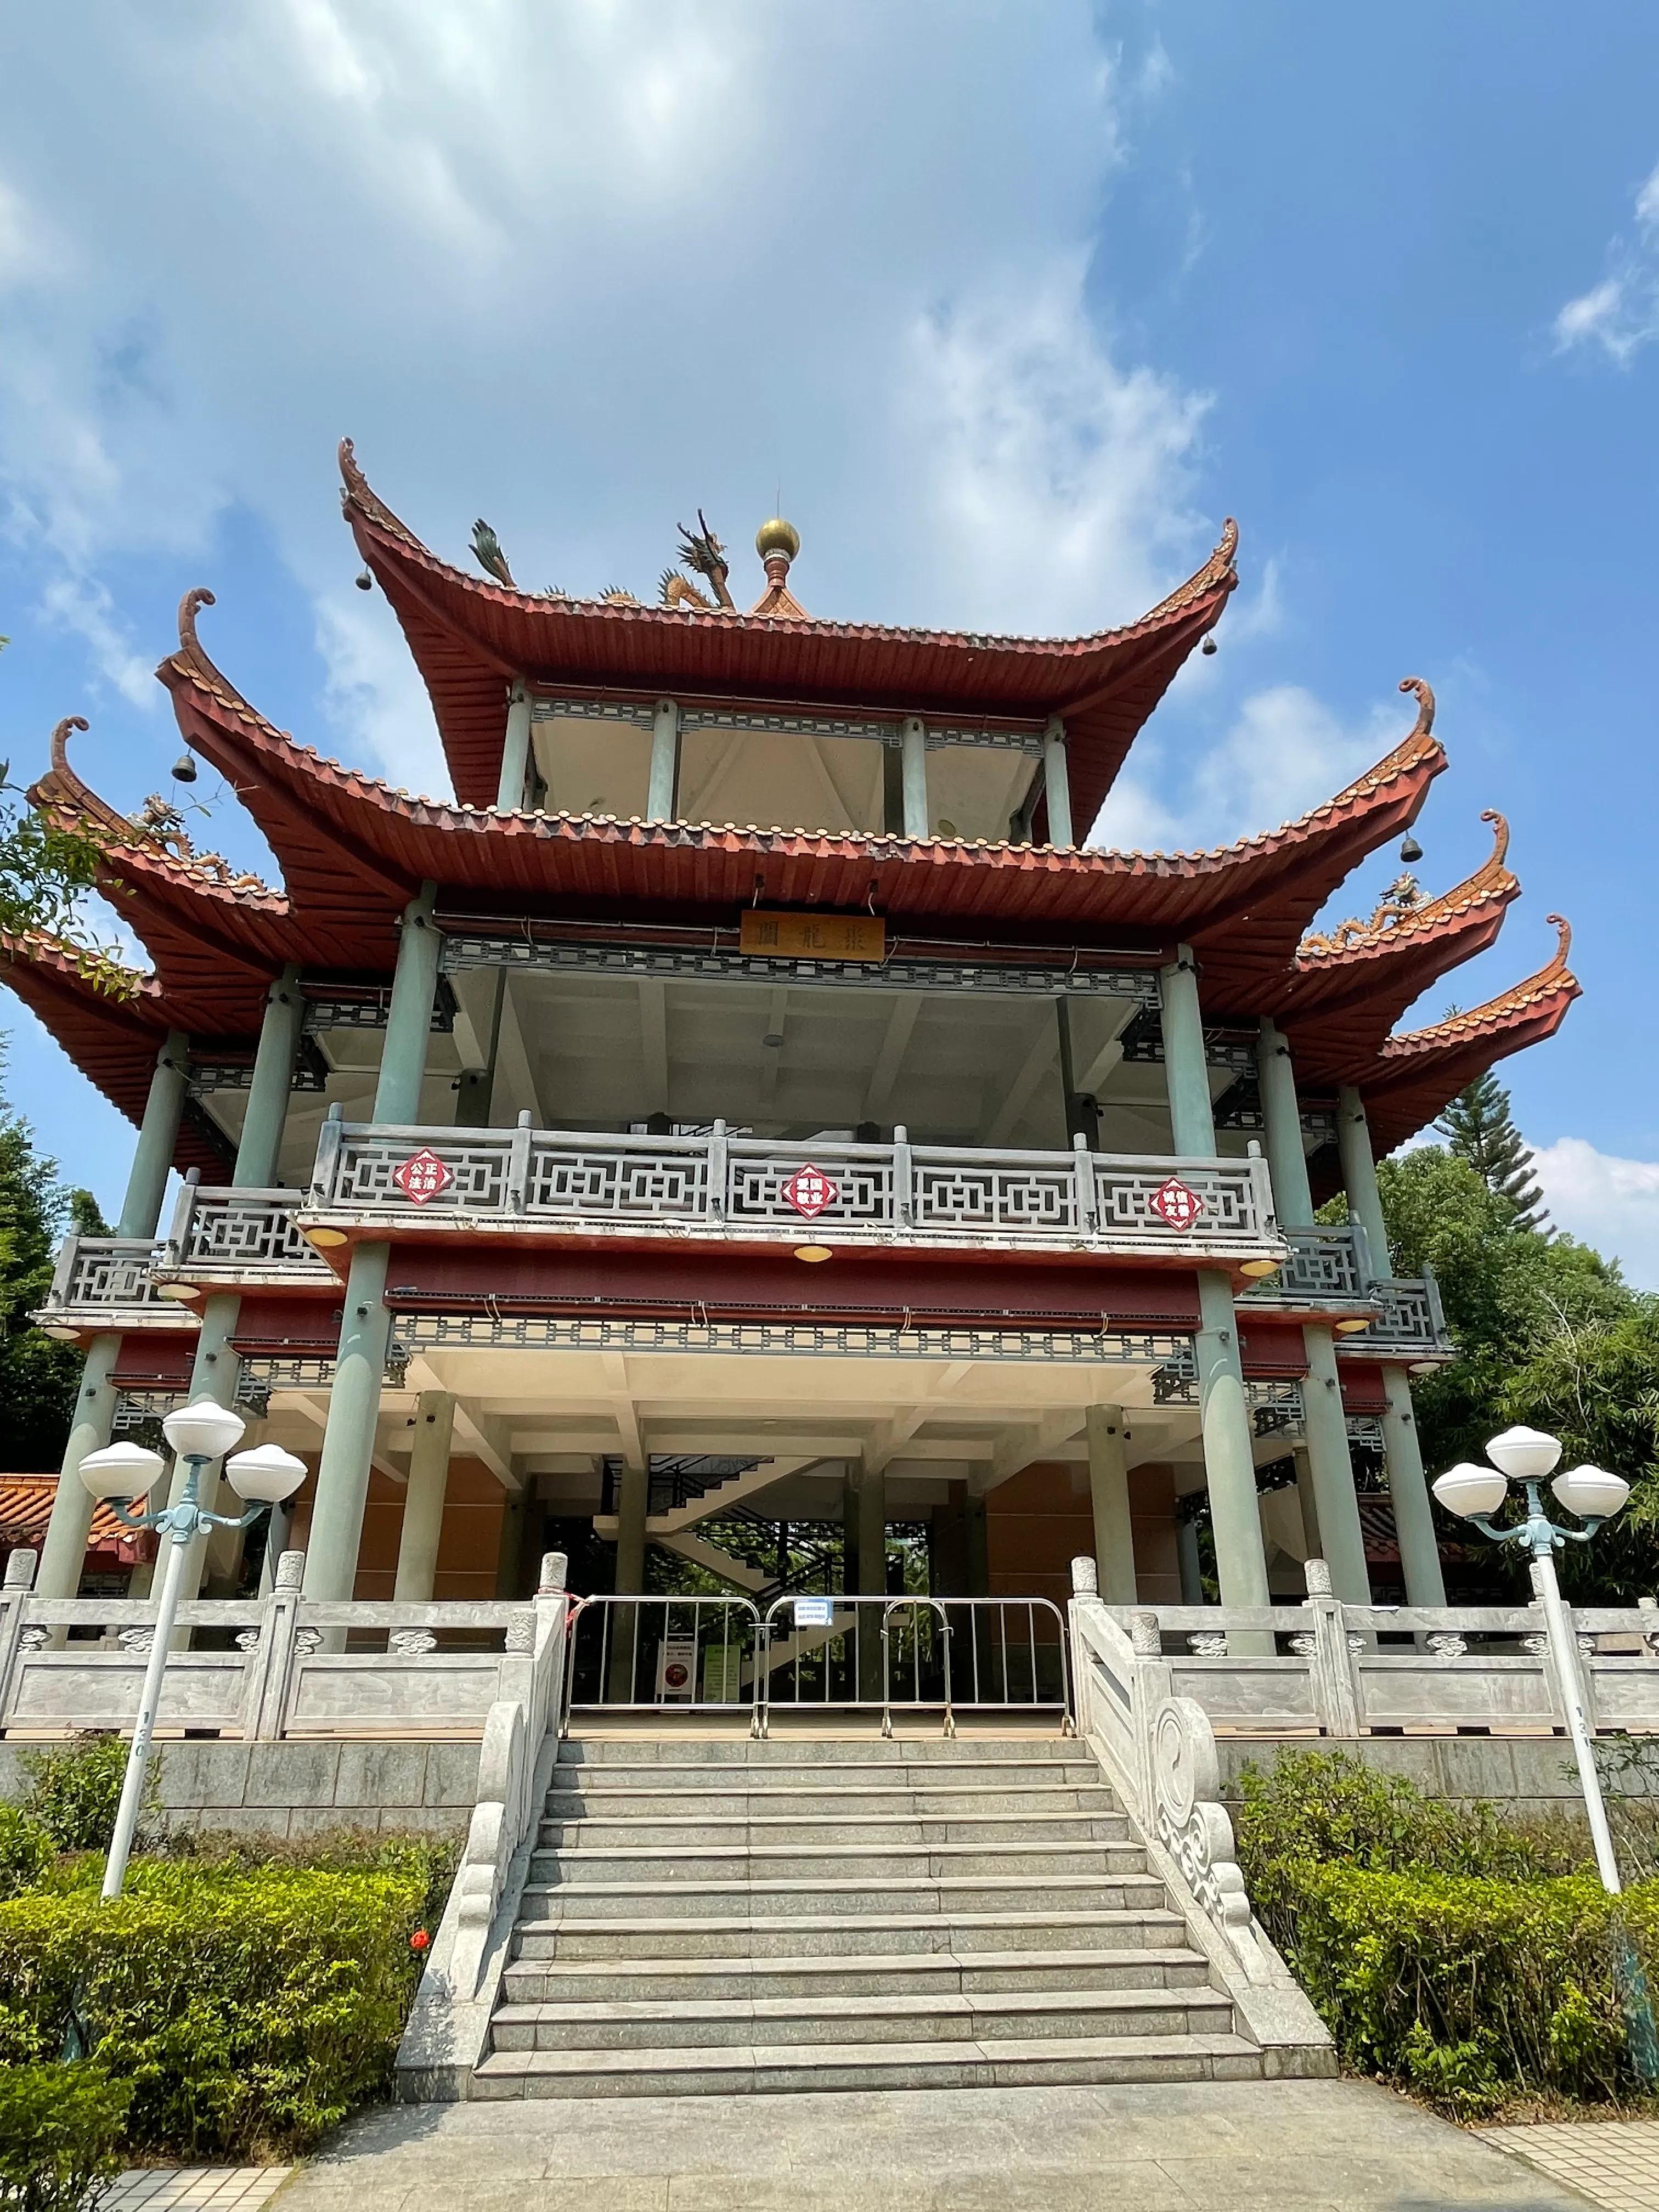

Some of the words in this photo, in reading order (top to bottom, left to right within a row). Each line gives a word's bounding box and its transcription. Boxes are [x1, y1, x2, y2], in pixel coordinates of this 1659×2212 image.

[410, 1163, 438, 1175] 公正
[408, 1176, 437, 1189] 法治
[797, 1178, 823, 1190] 爱国
[797, 1192, 823, 1205] 敬业
[1163, 1190, 1188, 1203] 诚信
[1164, 1204, 1189, 1217] 友善
